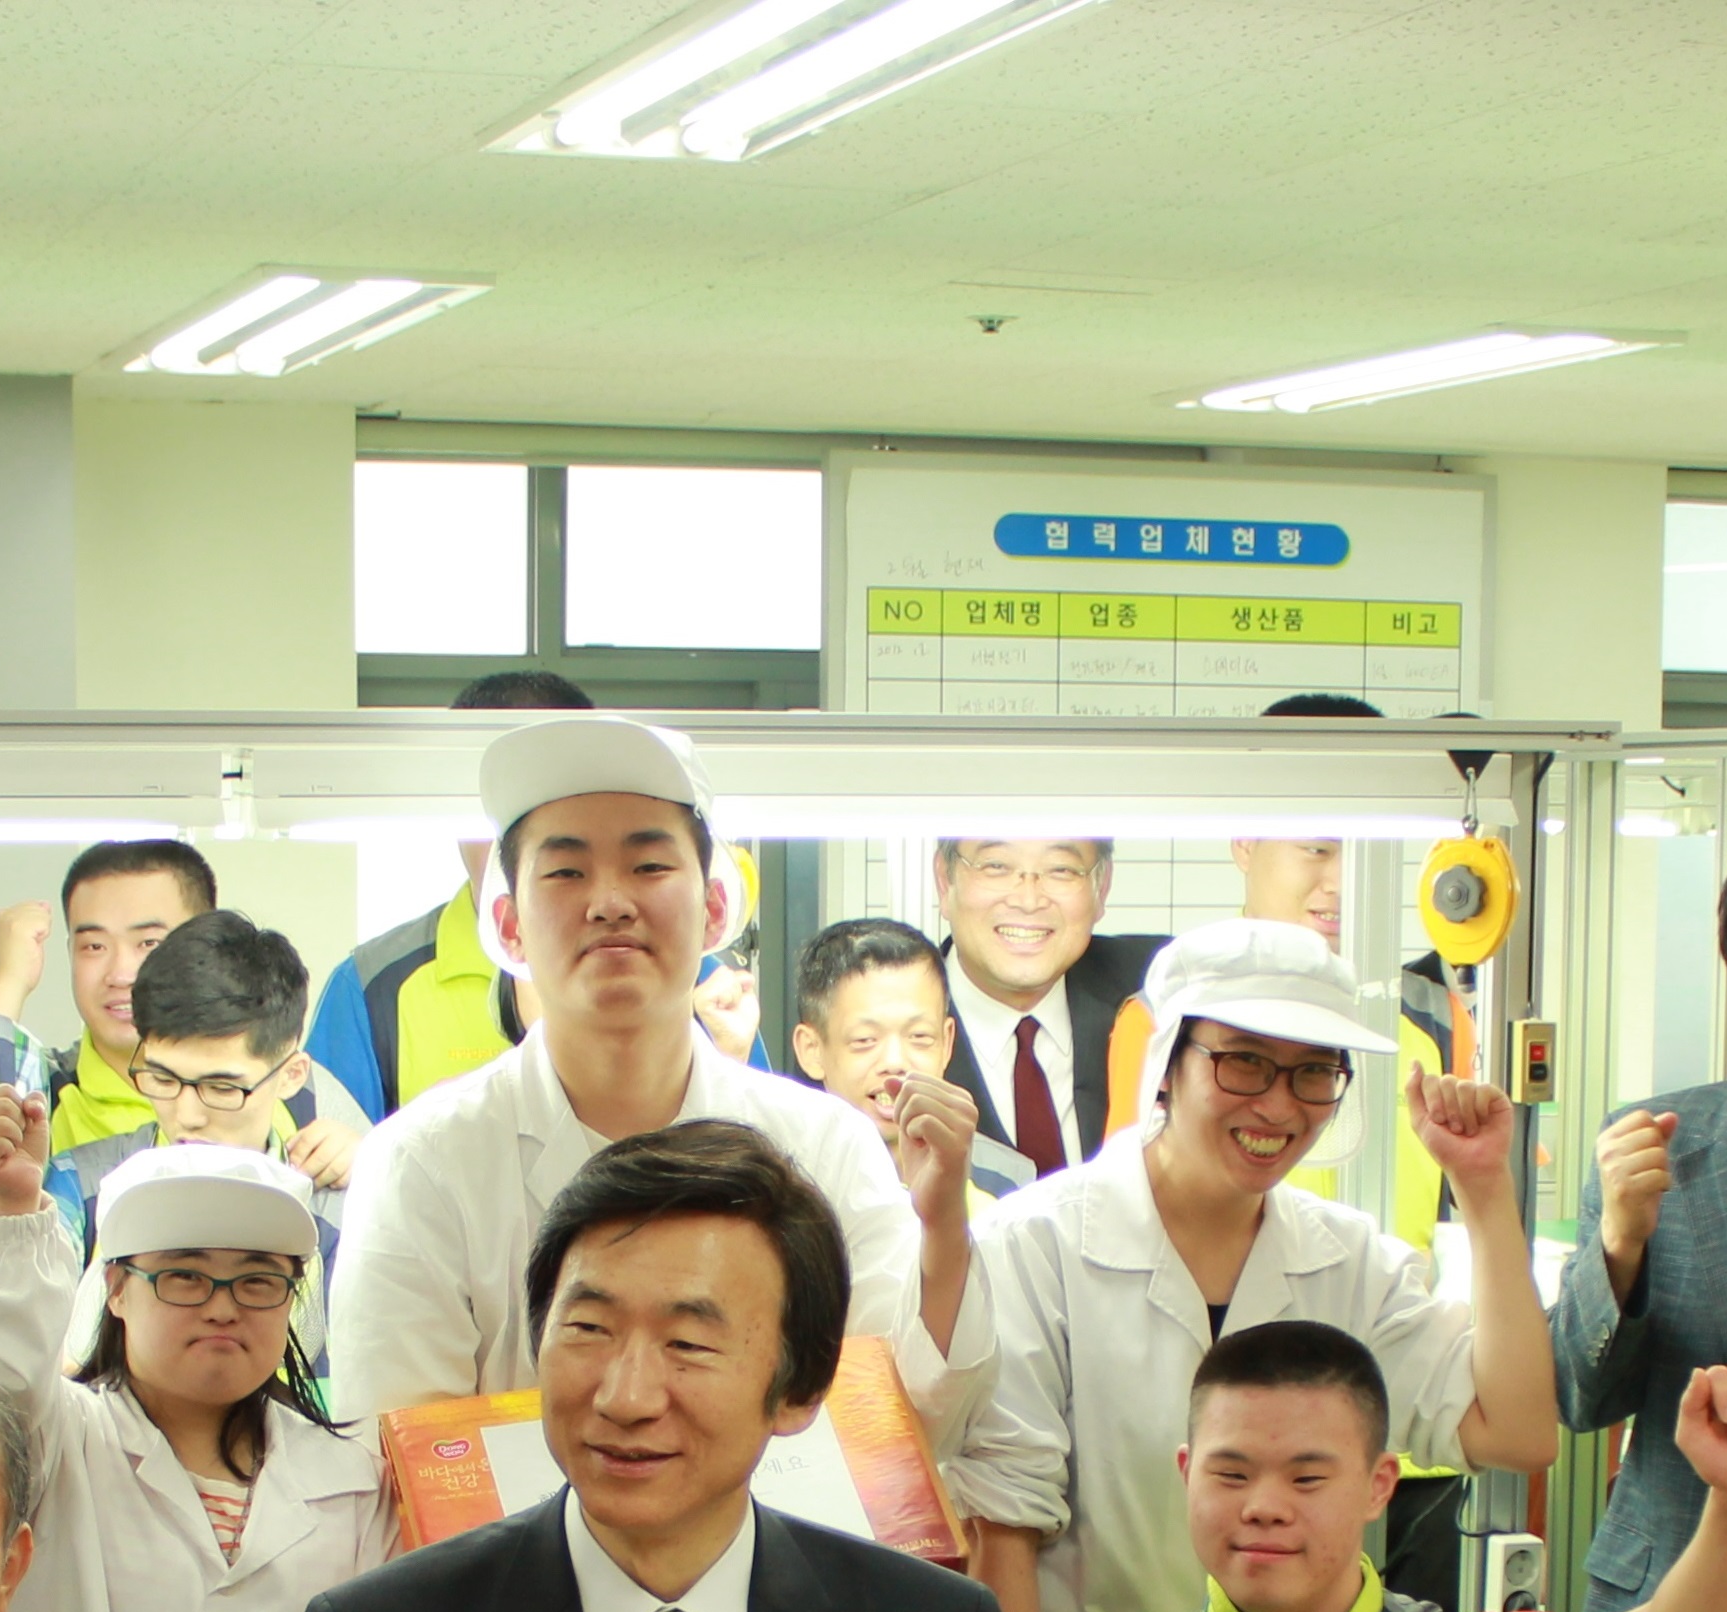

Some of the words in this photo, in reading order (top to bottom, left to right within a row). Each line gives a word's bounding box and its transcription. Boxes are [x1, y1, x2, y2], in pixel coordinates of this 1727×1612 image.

[884, 600, 923, 621] NO
[966, 600, 1041, 627] 업체명
[1090, 603, 1138, 628] 업종
[1231, 607, 1304, 632] 생산품
[1392, 612, 1438, 635] 비고
